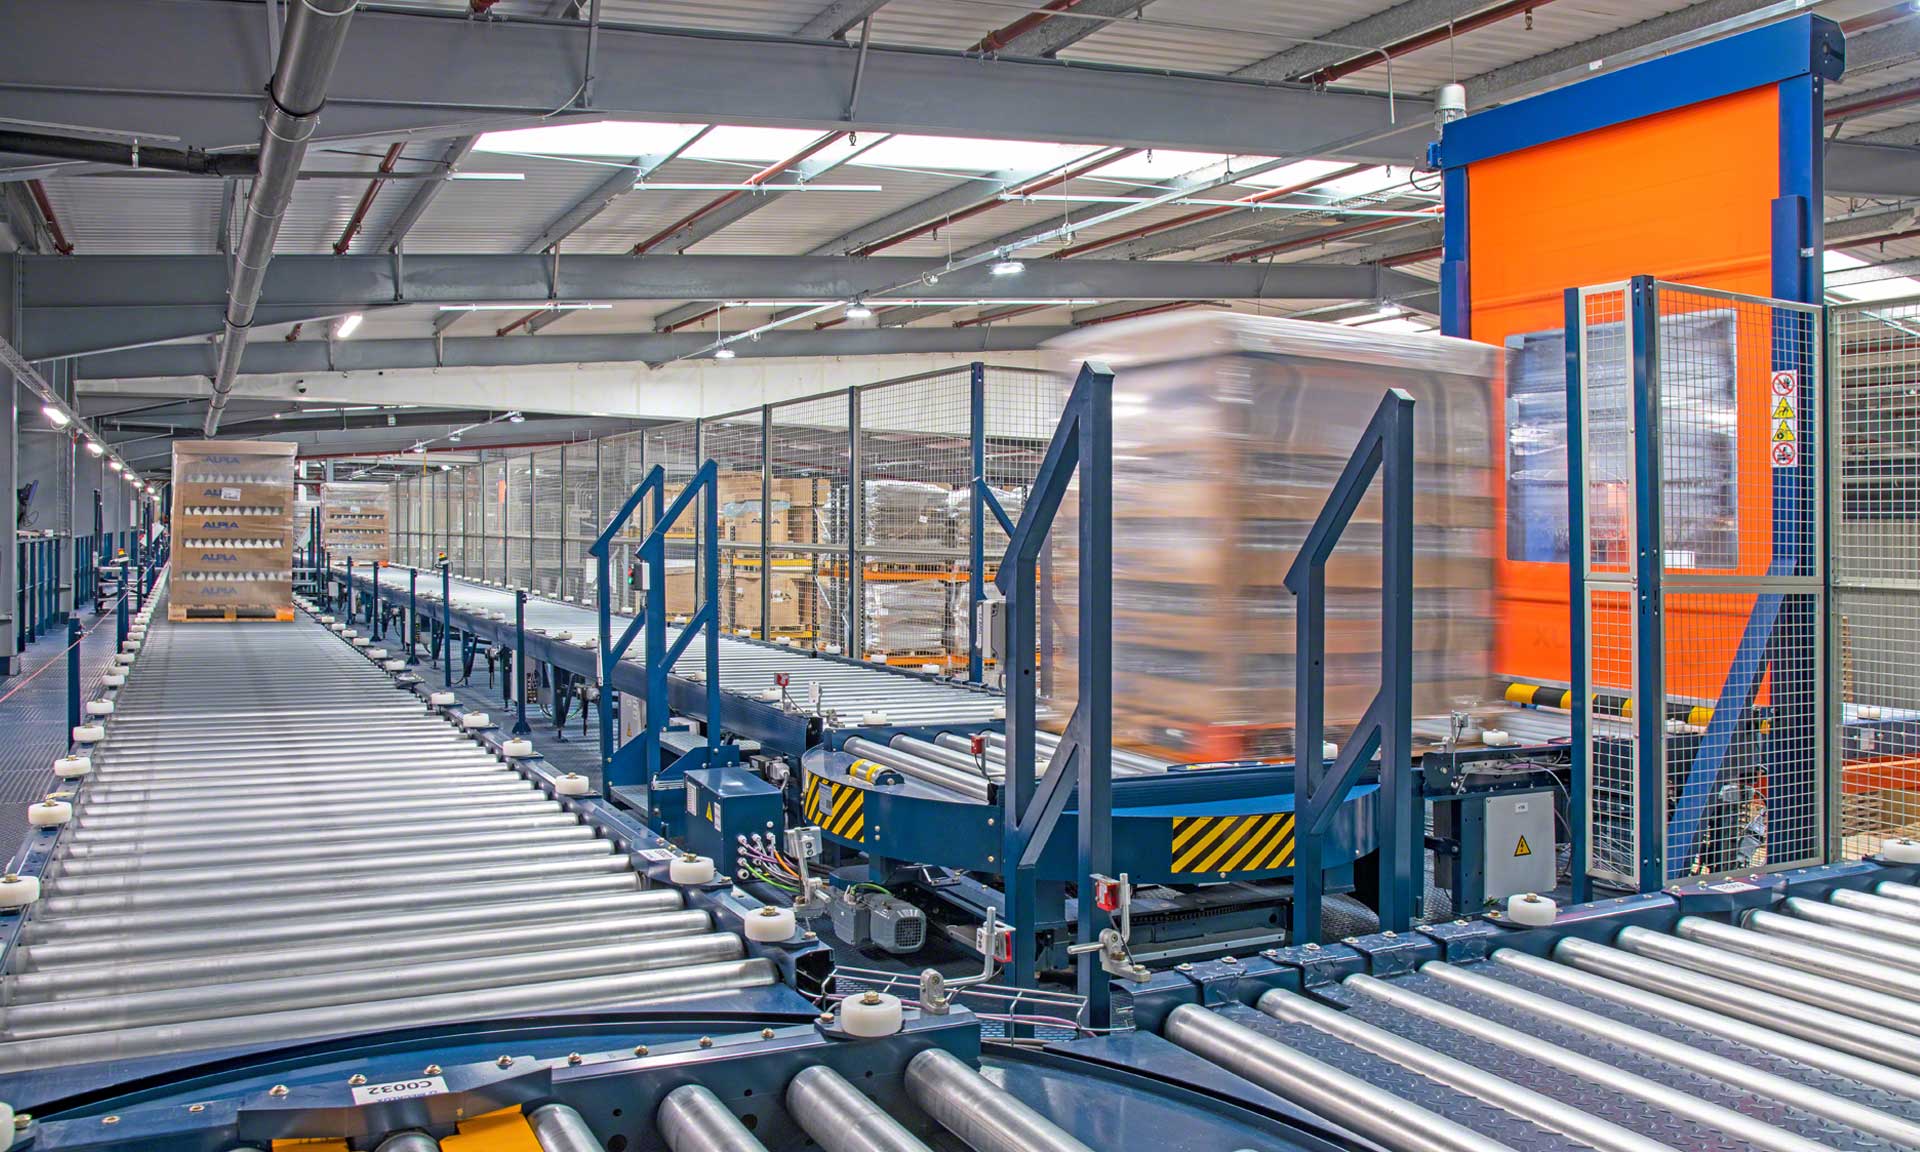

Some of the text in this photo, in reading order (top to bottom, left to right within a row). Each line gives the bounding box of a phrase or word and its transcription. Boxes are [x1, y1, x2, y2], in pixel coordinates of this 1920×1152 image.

[203, 521, 239, 529] ALPLA
[201, 553, 238, 561] ALPLA
[368, 1080, 432, 1095] C0032
